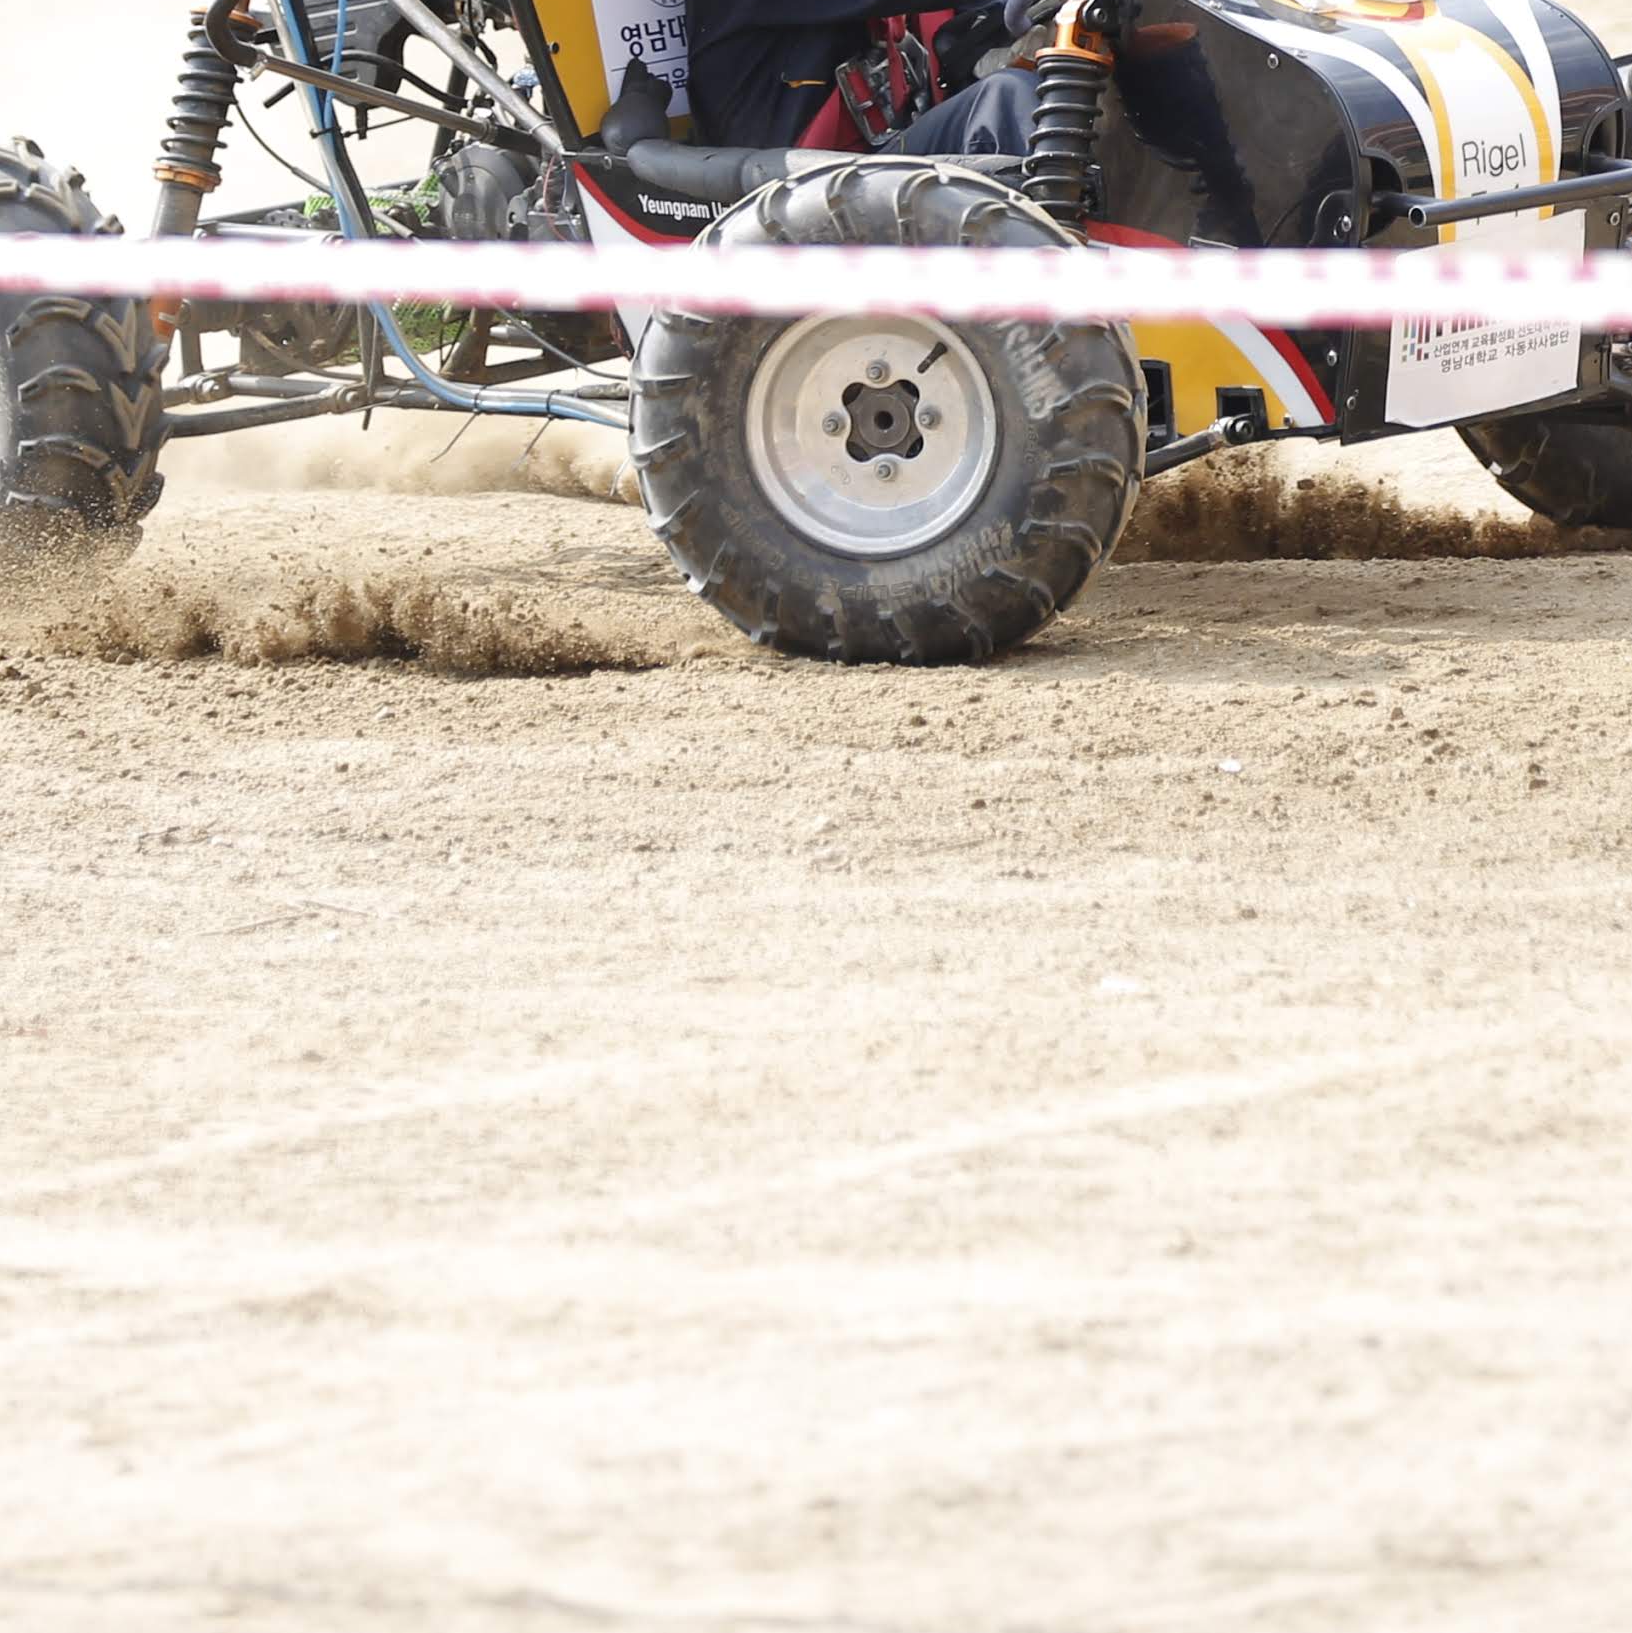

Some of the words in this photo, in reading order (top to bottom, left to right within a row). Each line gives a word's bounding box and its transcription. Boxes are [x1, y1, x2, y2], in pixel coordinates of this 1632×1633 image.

[1461, 132, 1527, 178] Rigel
[637, 193, 711, 221] Yeungnam
[1440, 348, 1499, 374] 영남대학교
[1504, 330, 1570, 357] 자동차사업단
